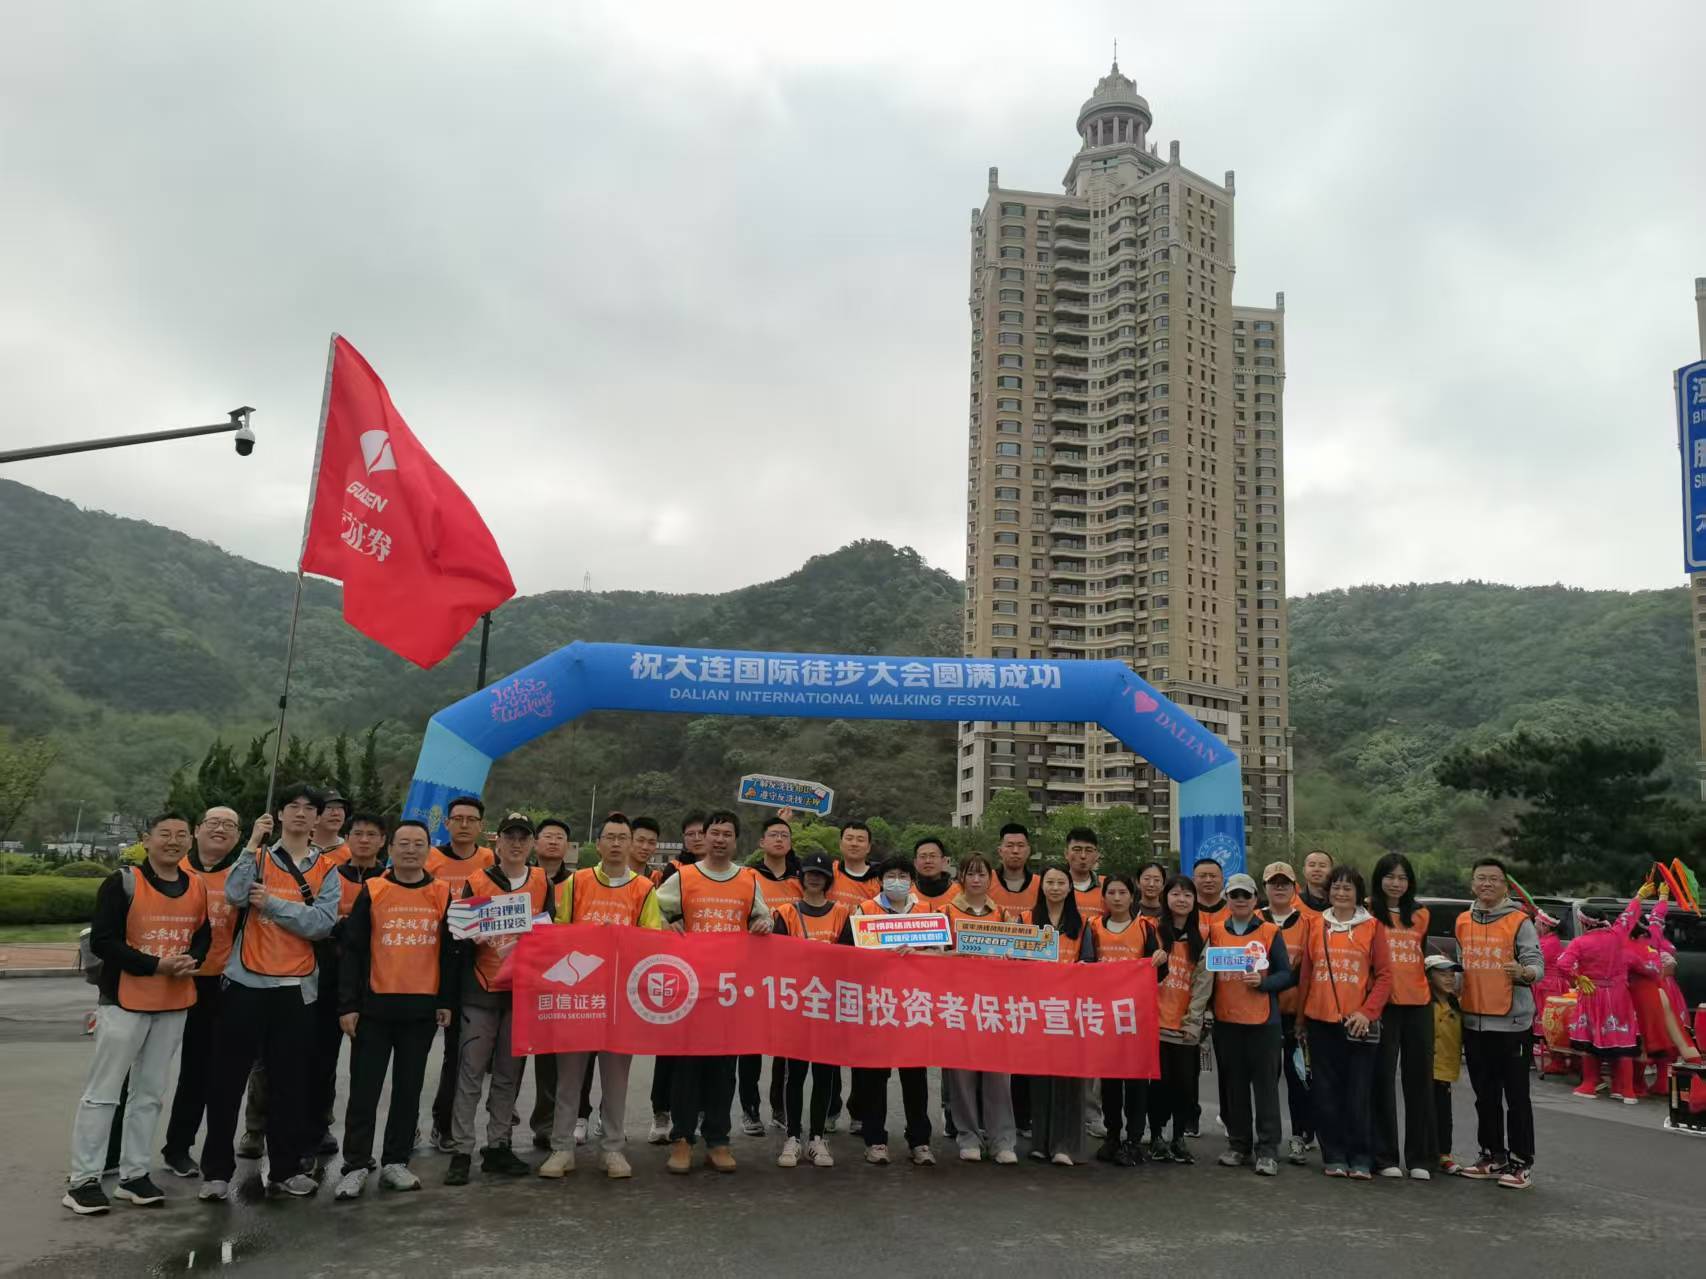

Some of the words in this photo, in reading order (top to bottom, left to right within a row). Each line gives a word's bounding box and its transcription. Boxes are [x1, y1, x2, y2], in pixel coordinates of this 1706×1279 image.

[630, 652, 1061, 689] 祝大连国际徒步大会圆满成功
[670, 687, 729, 701] DALIAN
[735, 691, 863, 705] INTERNATIONAL
[870, 693, 942, 706] WALKING
[947, 695, 1021, 706] FESTIVAL
[1155, 712, 1218, 763] DALIAN
[538, 994, 607, 1010] 国信证券
[718, 972, 1137, 1037] 5·15全国投资者保护宣传日
